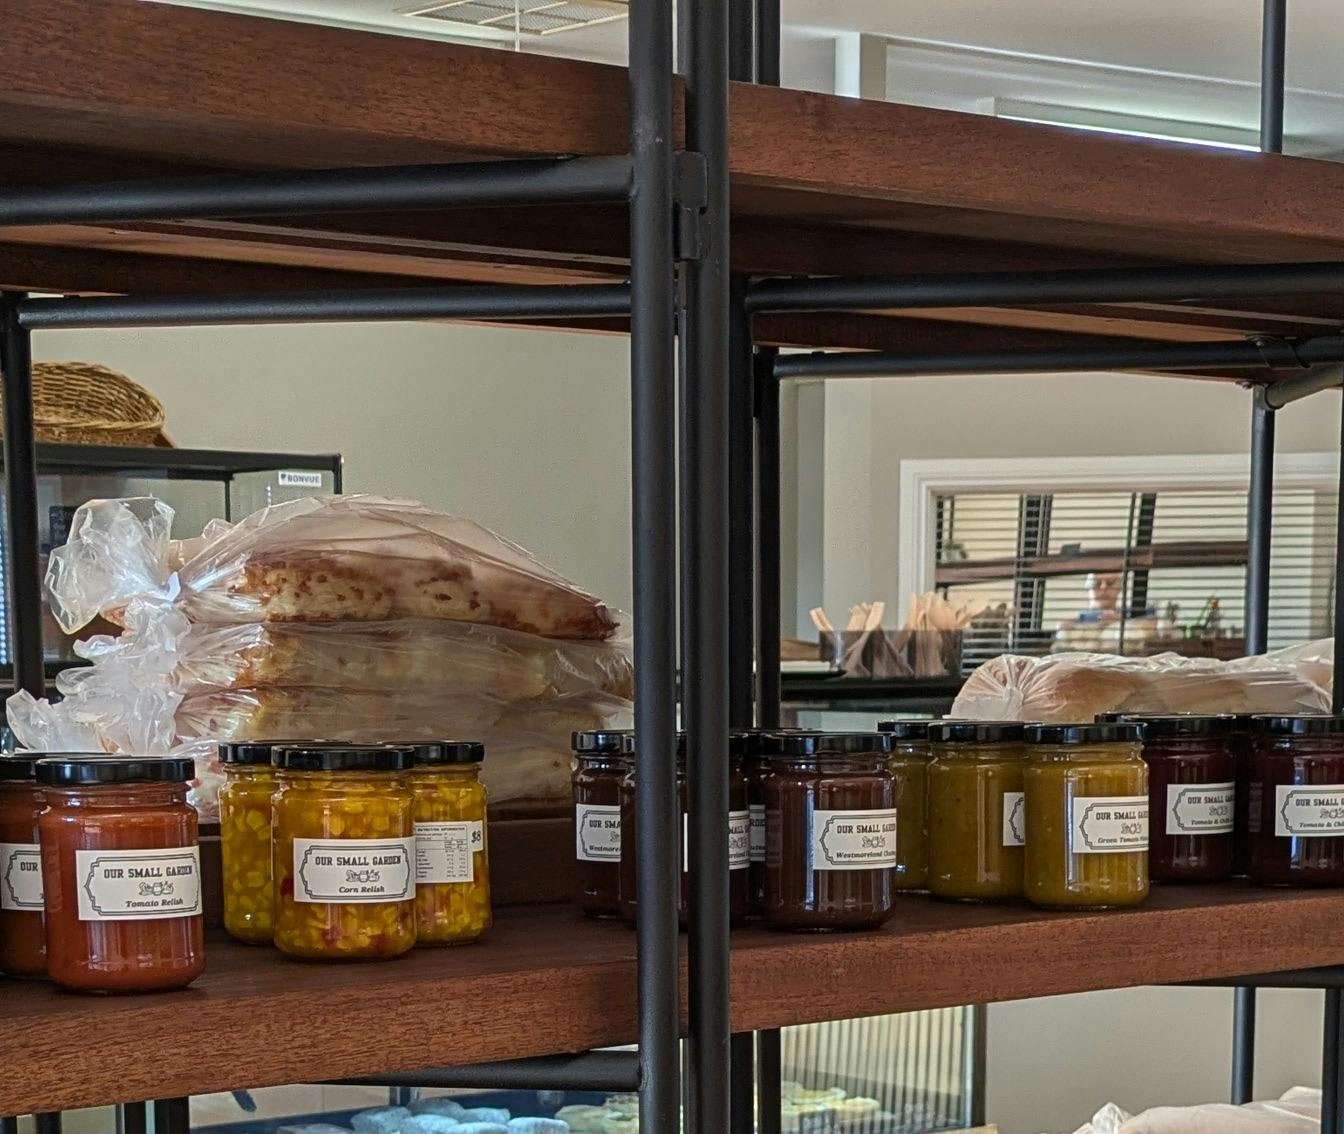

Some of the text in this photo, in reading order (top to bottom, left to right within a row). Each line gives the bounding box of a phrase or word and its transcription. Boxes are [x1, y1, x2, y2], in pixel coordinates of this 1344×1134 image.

[288, 475, 320, 483] BONVUE
[1187, 796, 1223, 804] OUR SMALL
[1296, 798, 1339, 807] OUR SMALL
[1095, 812, 1136, 821] OUR SMALL
[589, 820, 602, 828] OUR
[837, 824, 880, 834] OUR SMALL
[471, 830, 481, 843] $8
[315, 855, 401, 866] OUR SMALL GARDEN
[20, 862, 38, 872] OUR
[104, 864, 193, 879] OUR SMALL GARDEN
[361, 885, 385, 893] Relish
[125, 897, 184, 908] Tomato Relish
